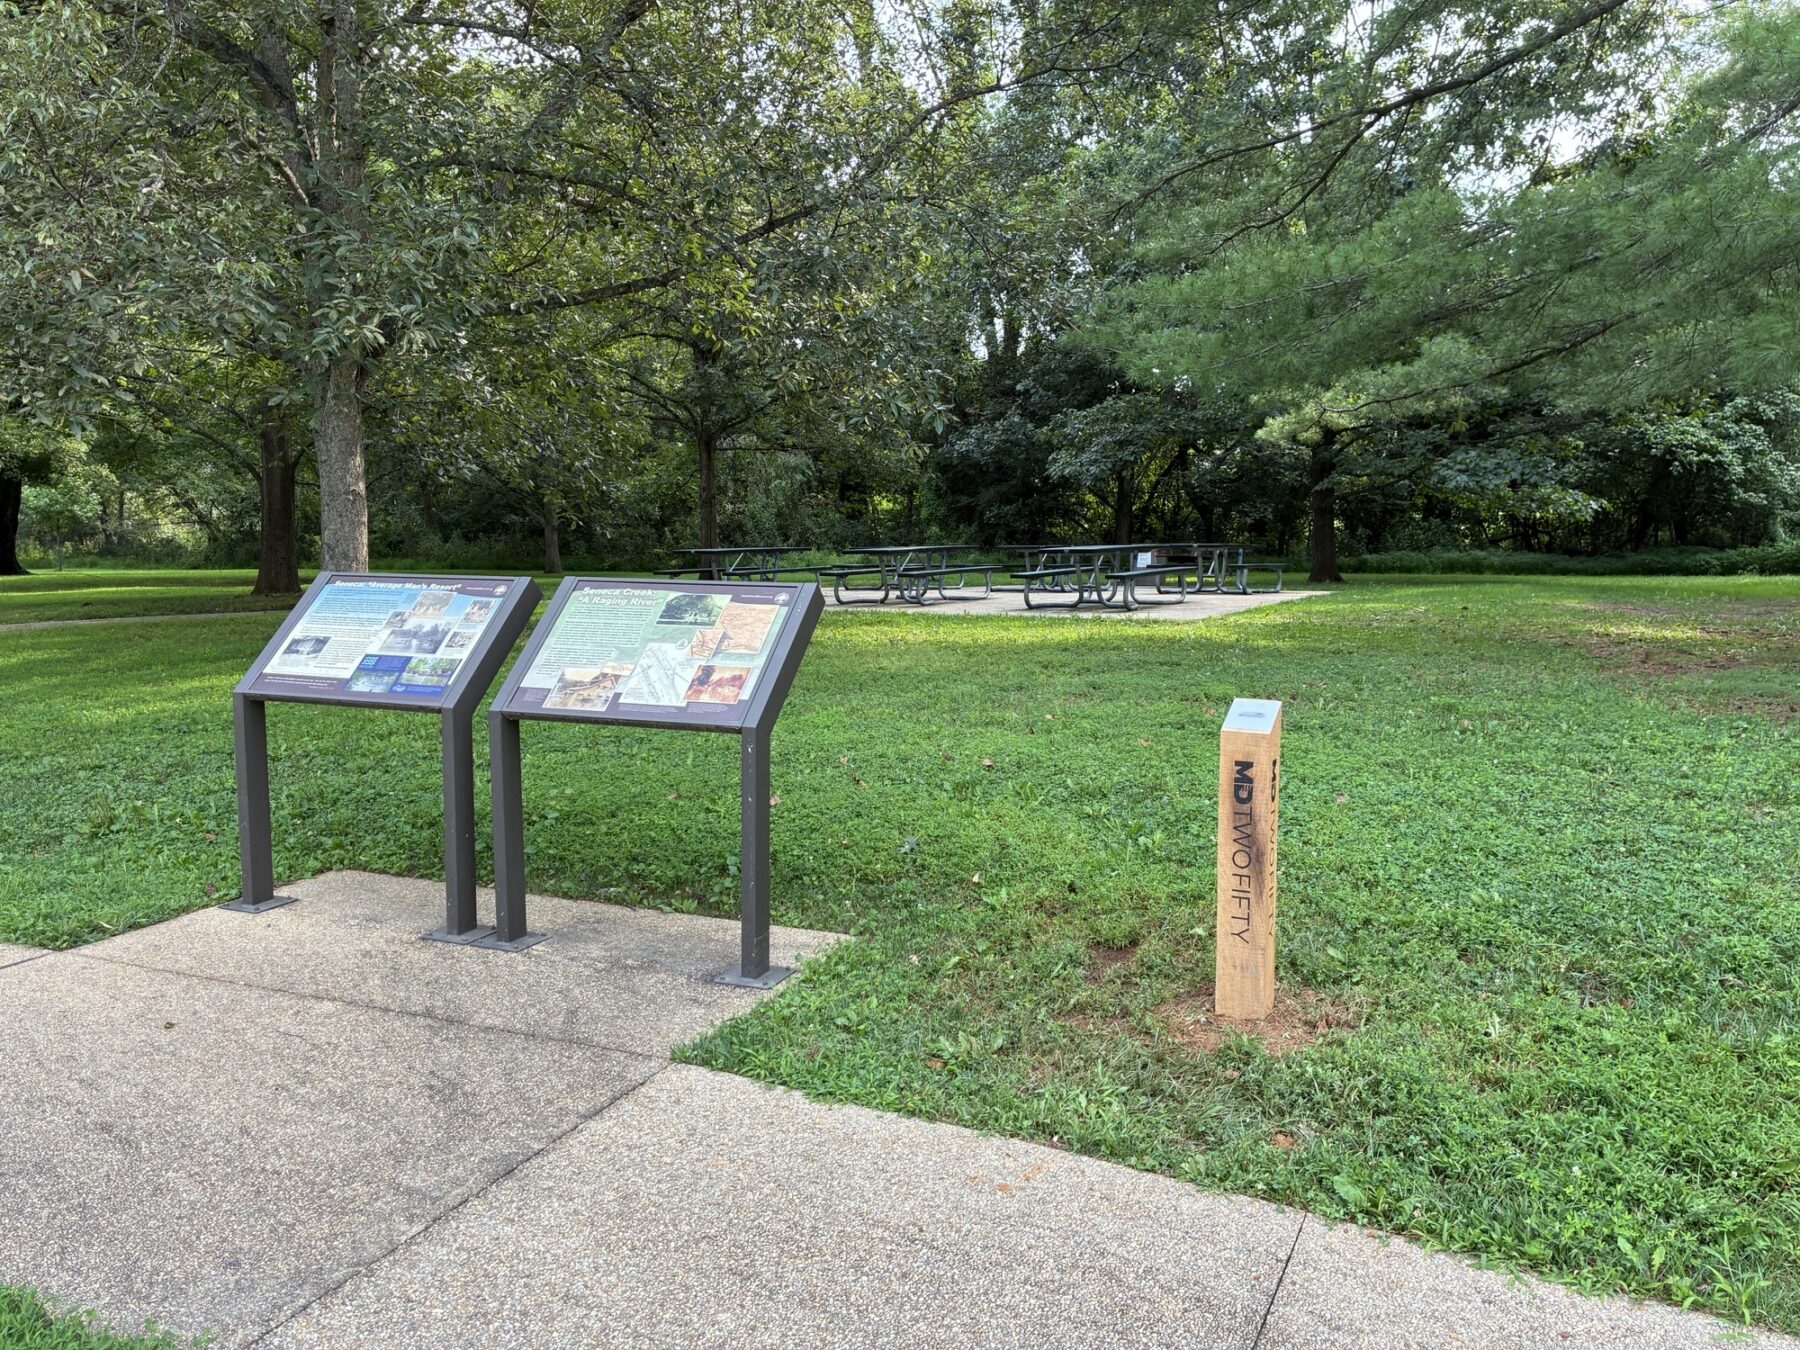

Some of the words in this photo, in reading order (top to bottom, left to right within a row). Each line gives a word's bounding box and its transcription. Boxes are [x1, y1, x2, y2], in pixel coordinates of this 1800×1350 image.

[582, 587, 620, 596] Seneca
[623, 588, 656, 597] Creek:
[592, 597, 627, 606] Raging
